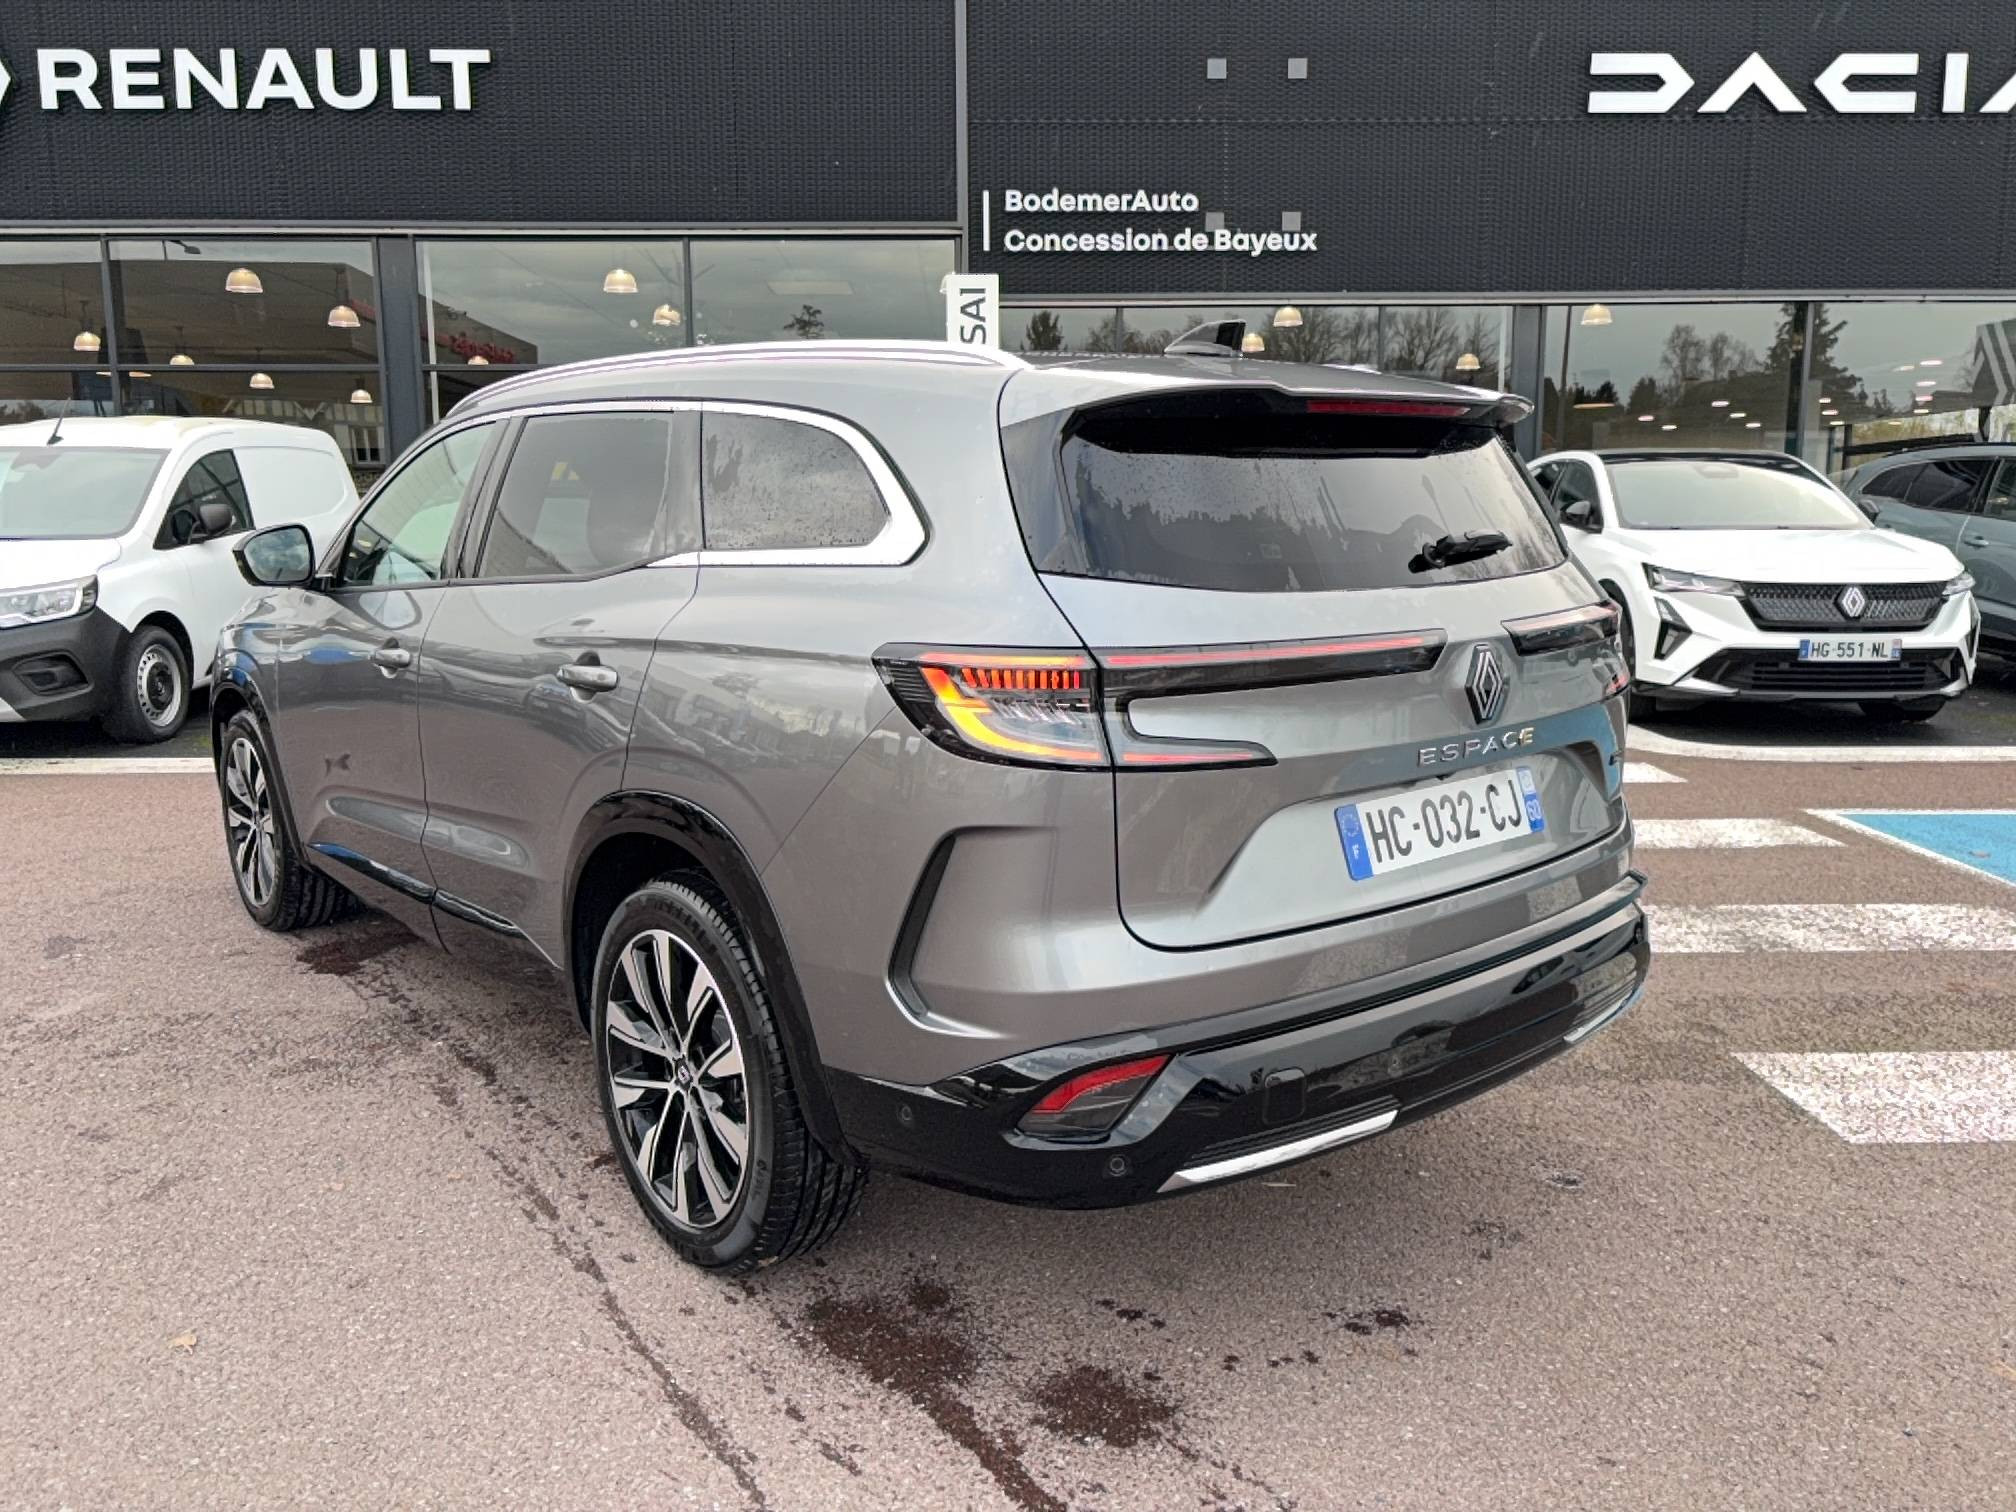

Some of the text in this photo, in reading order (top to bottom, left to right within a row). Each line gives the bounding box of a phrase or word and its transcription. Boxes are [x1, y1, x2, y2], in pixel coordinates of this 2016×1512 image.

[37, 48, 491, 111] RENAULT
[1004, 189, 1199, 213] BodemerAuto
[1003, 228, 1318, 257] Concession de Bayeux
[1418, 727, 1535, 767] ESPACE
[1364, 779, 1523, 864] HC-032-CJ
